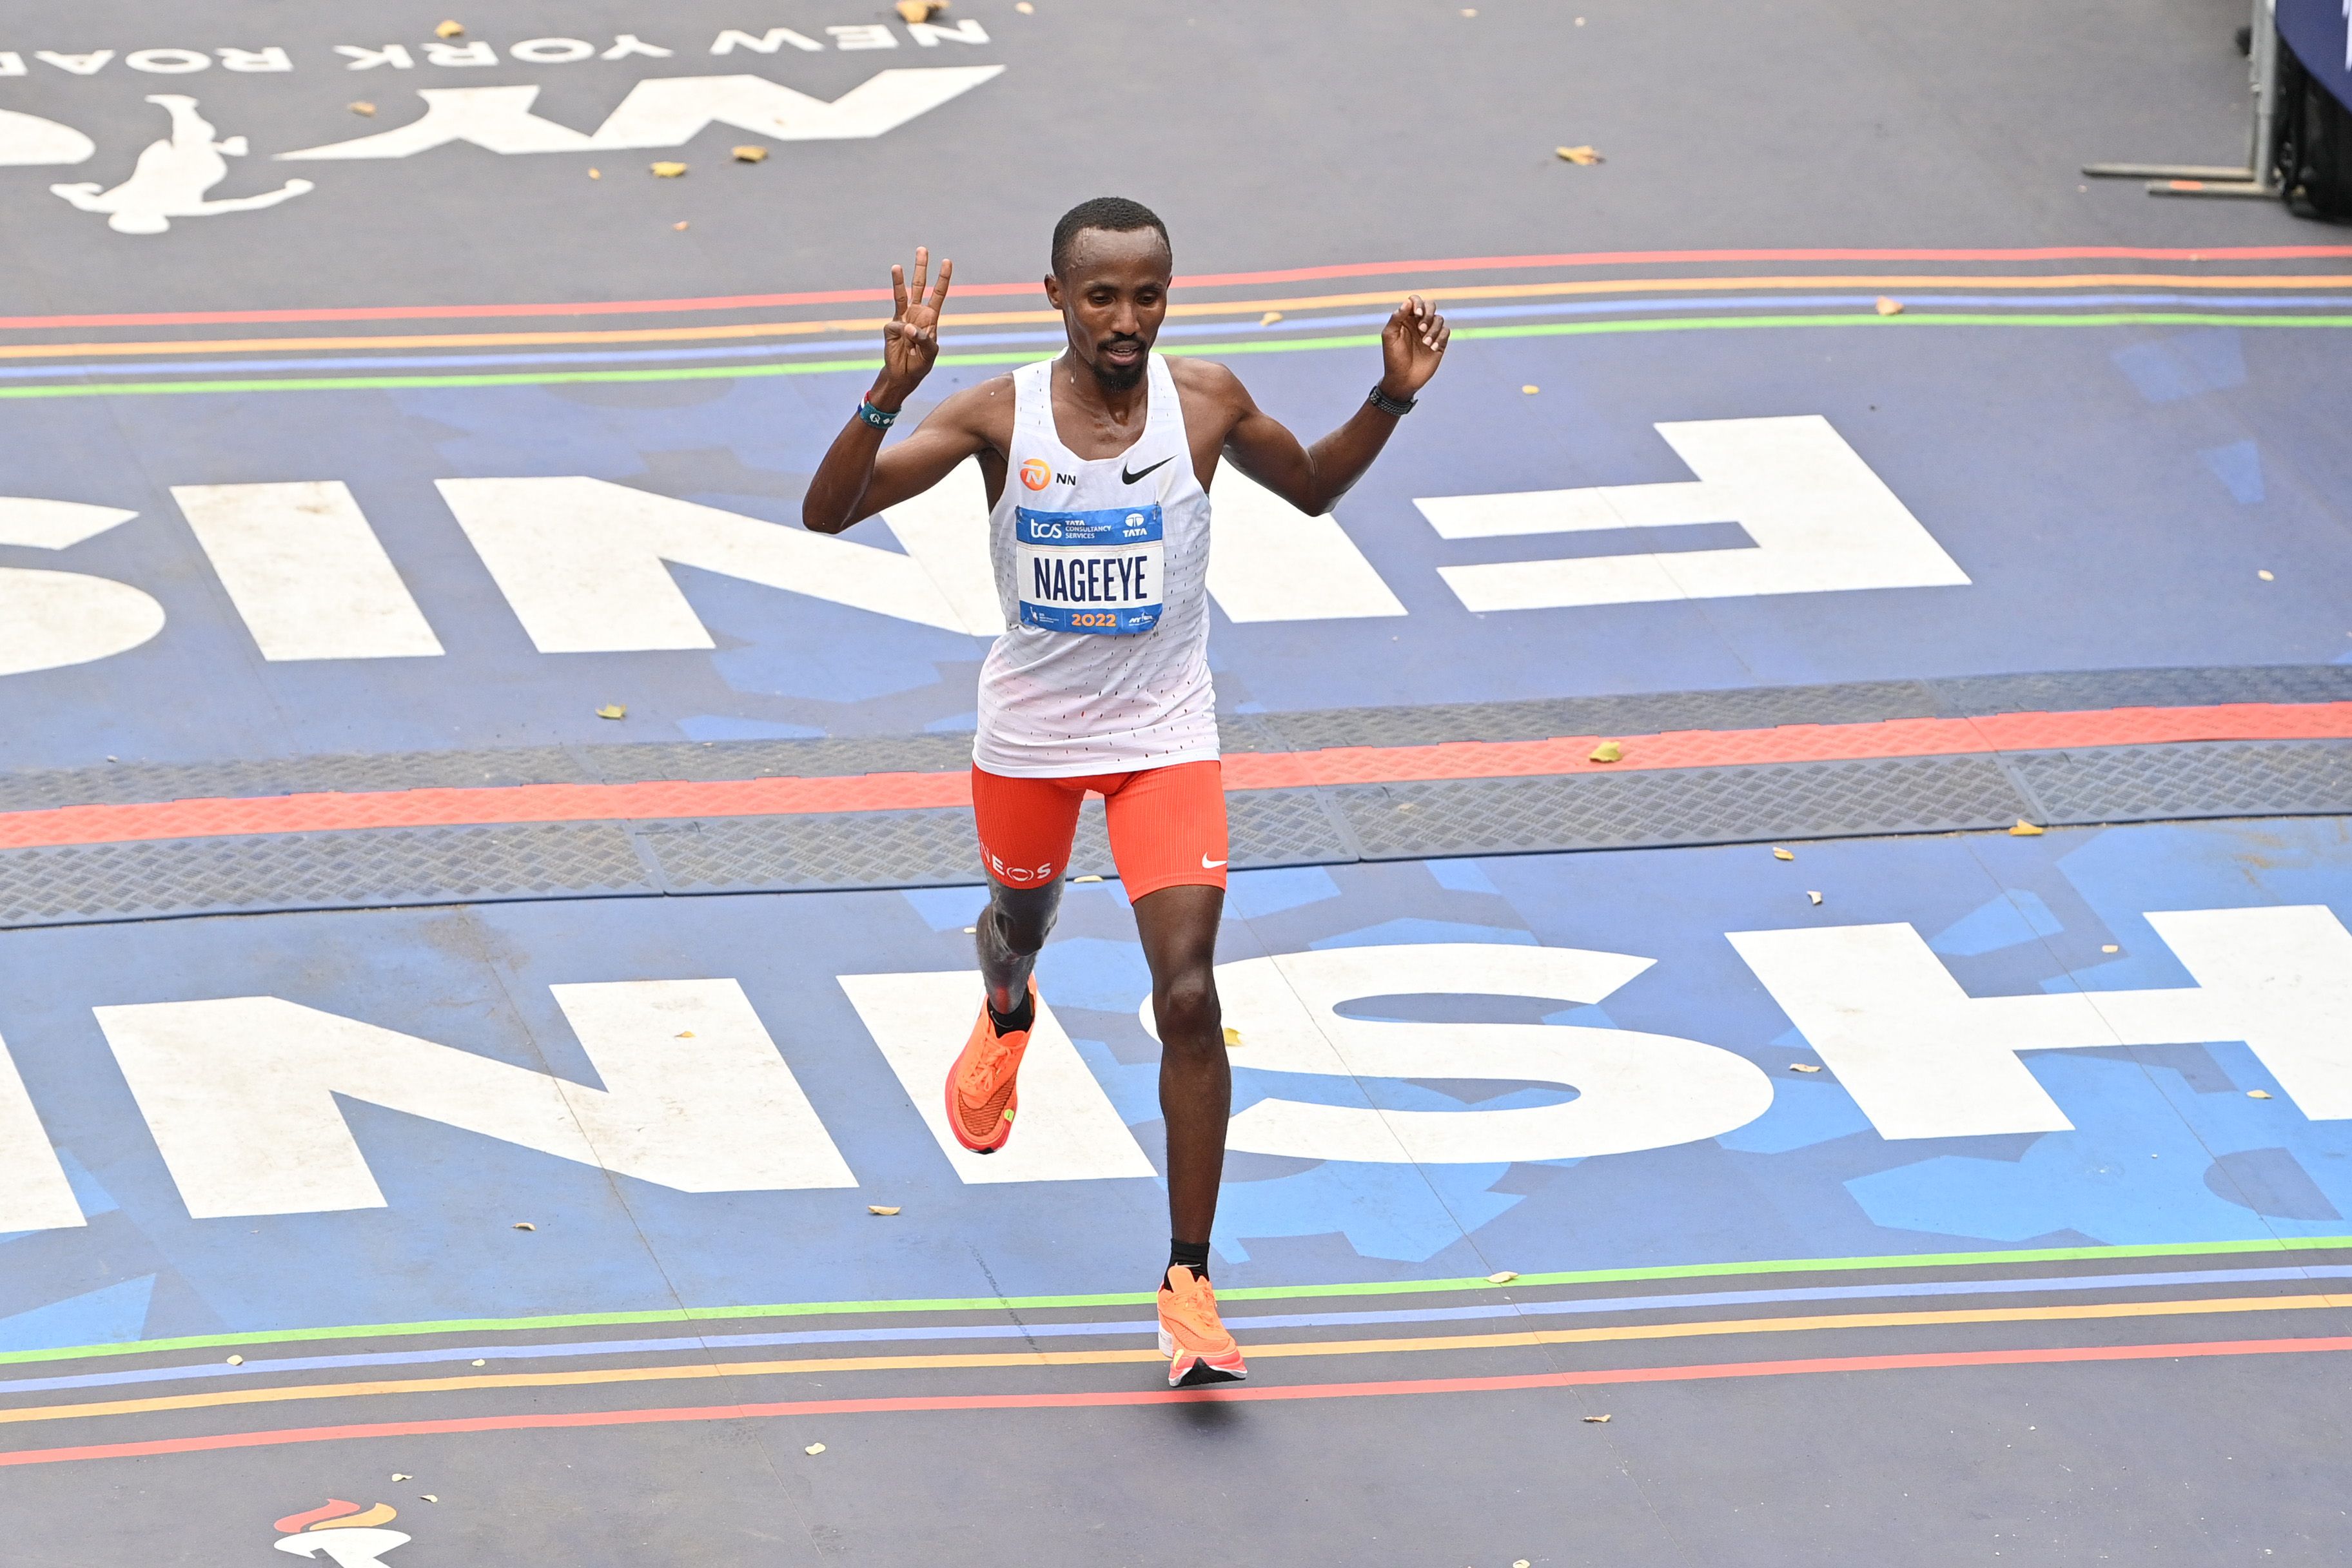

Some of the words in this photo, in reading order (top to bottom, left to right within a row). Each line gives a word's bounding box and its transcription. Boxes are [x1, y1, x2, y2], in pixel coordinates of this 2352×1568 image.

[333, 34, 674, 70] YORK
[710, 19, 991, 55] NEW
[1056, 473, 1076, 486] NN
[0, 414, 1971, 674] FINI
[1030, 518, 1063, 539] tcs
[1122, 527, 1148, 538] TATA
[1034, 555, 1148, 603] NAGEEYE
[1071, 613, 1117, 628] 2022
[979, 838, 1052, 882] NEOS
[0, 903, 2352, 1233] NISH
